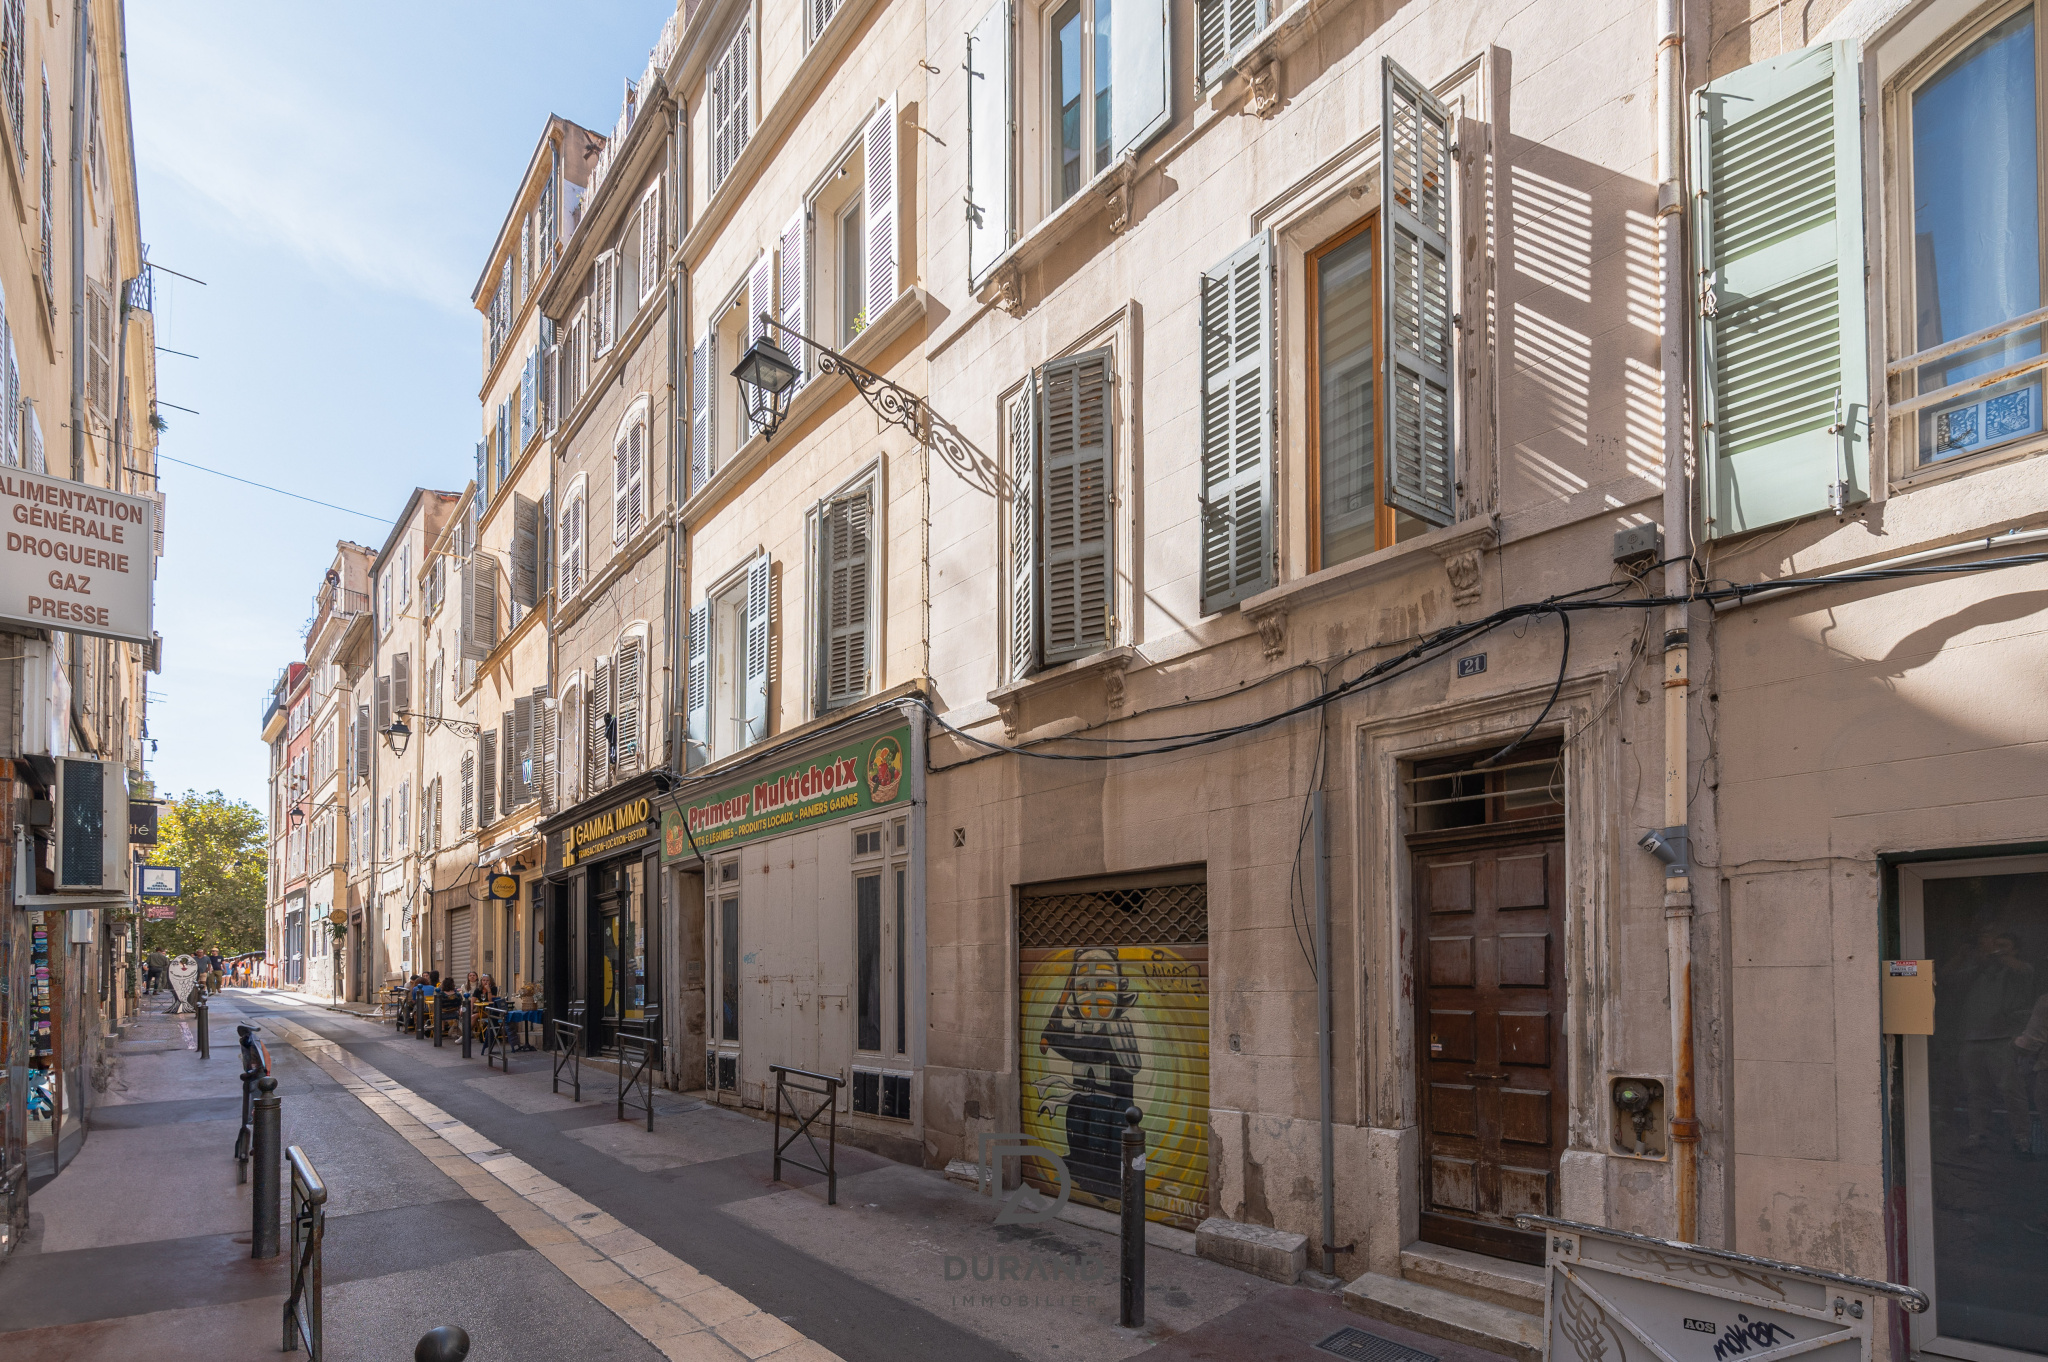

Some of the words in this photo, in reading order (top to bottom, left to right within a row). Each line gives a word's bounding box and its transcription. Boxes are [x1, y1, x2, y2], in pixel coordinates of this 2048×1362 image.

[13, 503, 124, 544] GÉNÉRALE
[7, 532, 129, 573] DROGUERIE
[48, 570, 91, 594] GAZ
[28, 595, 109, 627] PRESSE
[1464, 657, 1480, 674] 21
[688, 792, 750, 835] Primeur
[753, 756, 858, 816] Multichoix
[738, 818, 767, 836] PRODUITS
[767, 811, 794, 828] LOCAUX
[800, 800, 828, 820] PANIERS
[829, 793, 858, 811] GARNIS
[576, 812, 615, 845] GAMMA
[616, 798, 649, 831] IMMO
[1684, 1319, 1716, 1333] AOS
